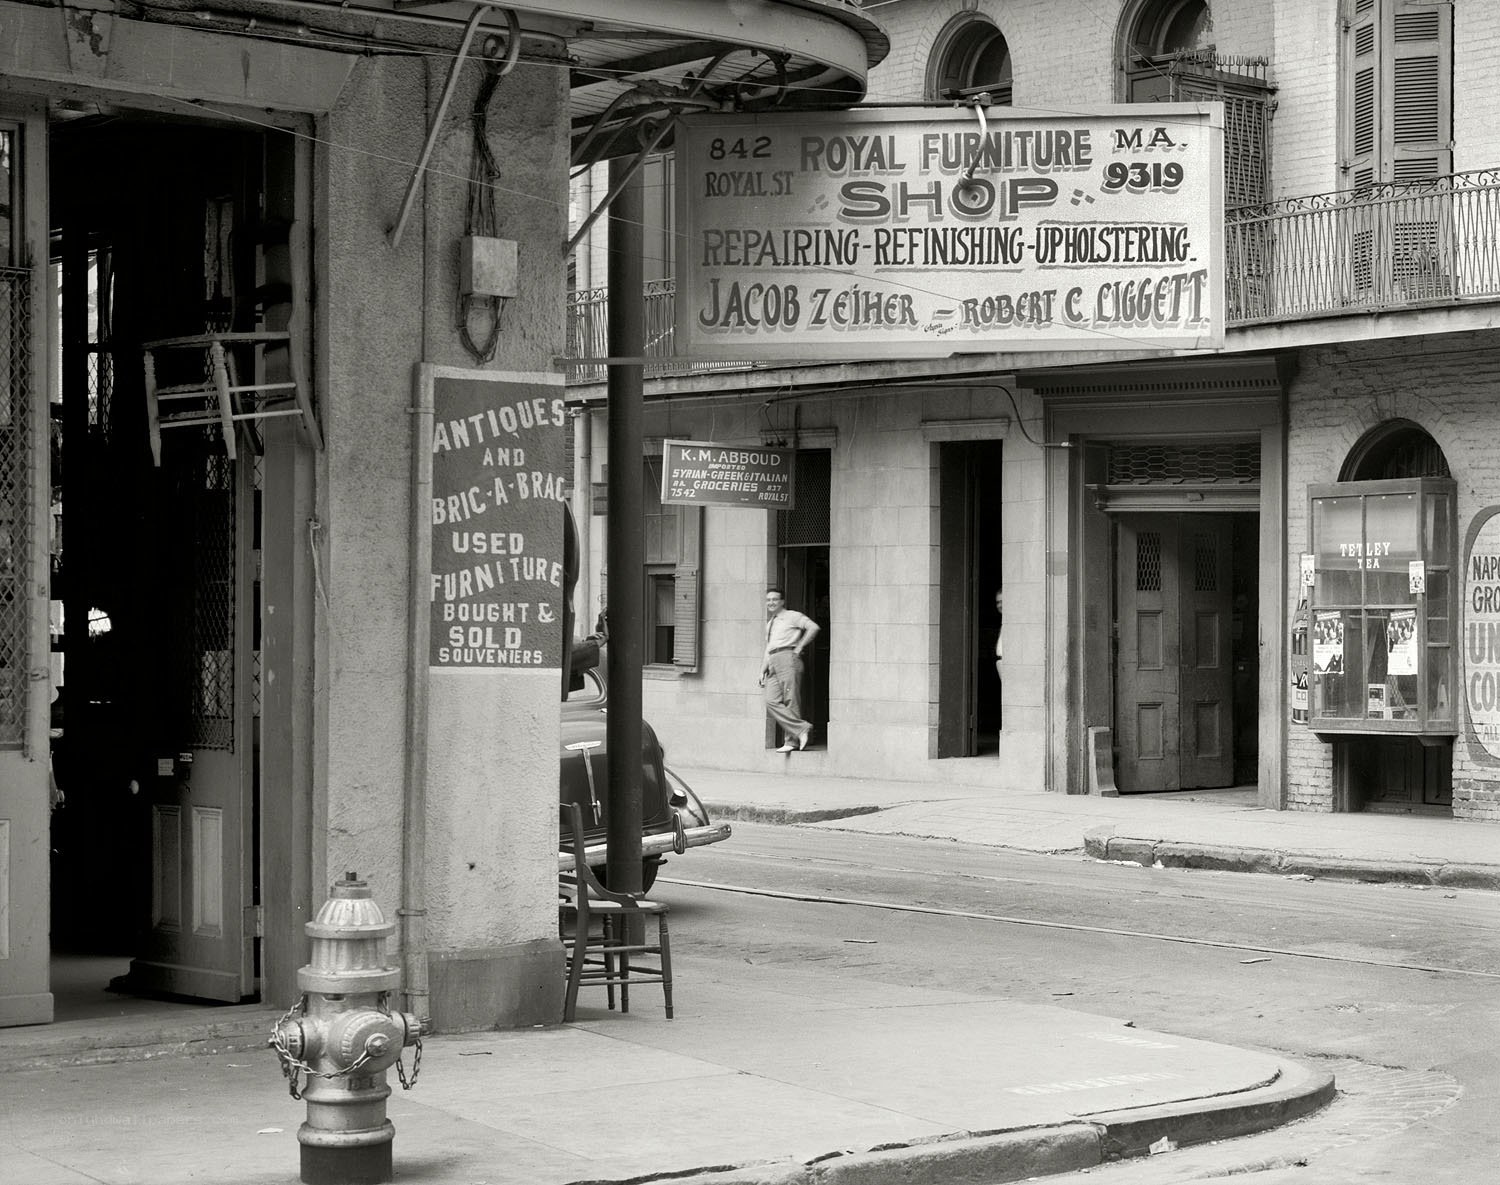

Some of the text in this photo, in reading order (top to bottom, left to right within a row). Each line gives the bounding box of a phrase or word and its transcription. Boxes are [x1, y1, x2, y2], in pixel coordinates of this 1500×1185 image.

[710, 136, 772, 161] 842
[801, 129, 1093, 174] ROYAL FURNITURE
[1103, 162, 1185, 190] 9319
[839, 177, 1060, 218] SHOP
[699, 278, 800, 327] JACOB
[962, 289, 1057, 326] ROBERT
[433, 398, 564, 453] ANTIQUES
[483, 447, 525, 466] AND
[708, 463, 746, 471] IMPORTED
[719, 451, 781, 466] ABBOUD
[671, 488, 696, 497] 7542
[758, 493, 779, 501] ROYAL
[693, 480, 758, 492] GROCERIES
[452, 531, 524, 554] USED
[1340, 542, 1390, 557] TETLEY
[1357, 558, 1380, 569] TEA
[430, 557, 562, 602] FURNITURE
[443, 603, 555, 623] BOUGHT &
[449, 626, 521, 649] SOLD
[439, 647, 542, 664] SOUVENIERS
